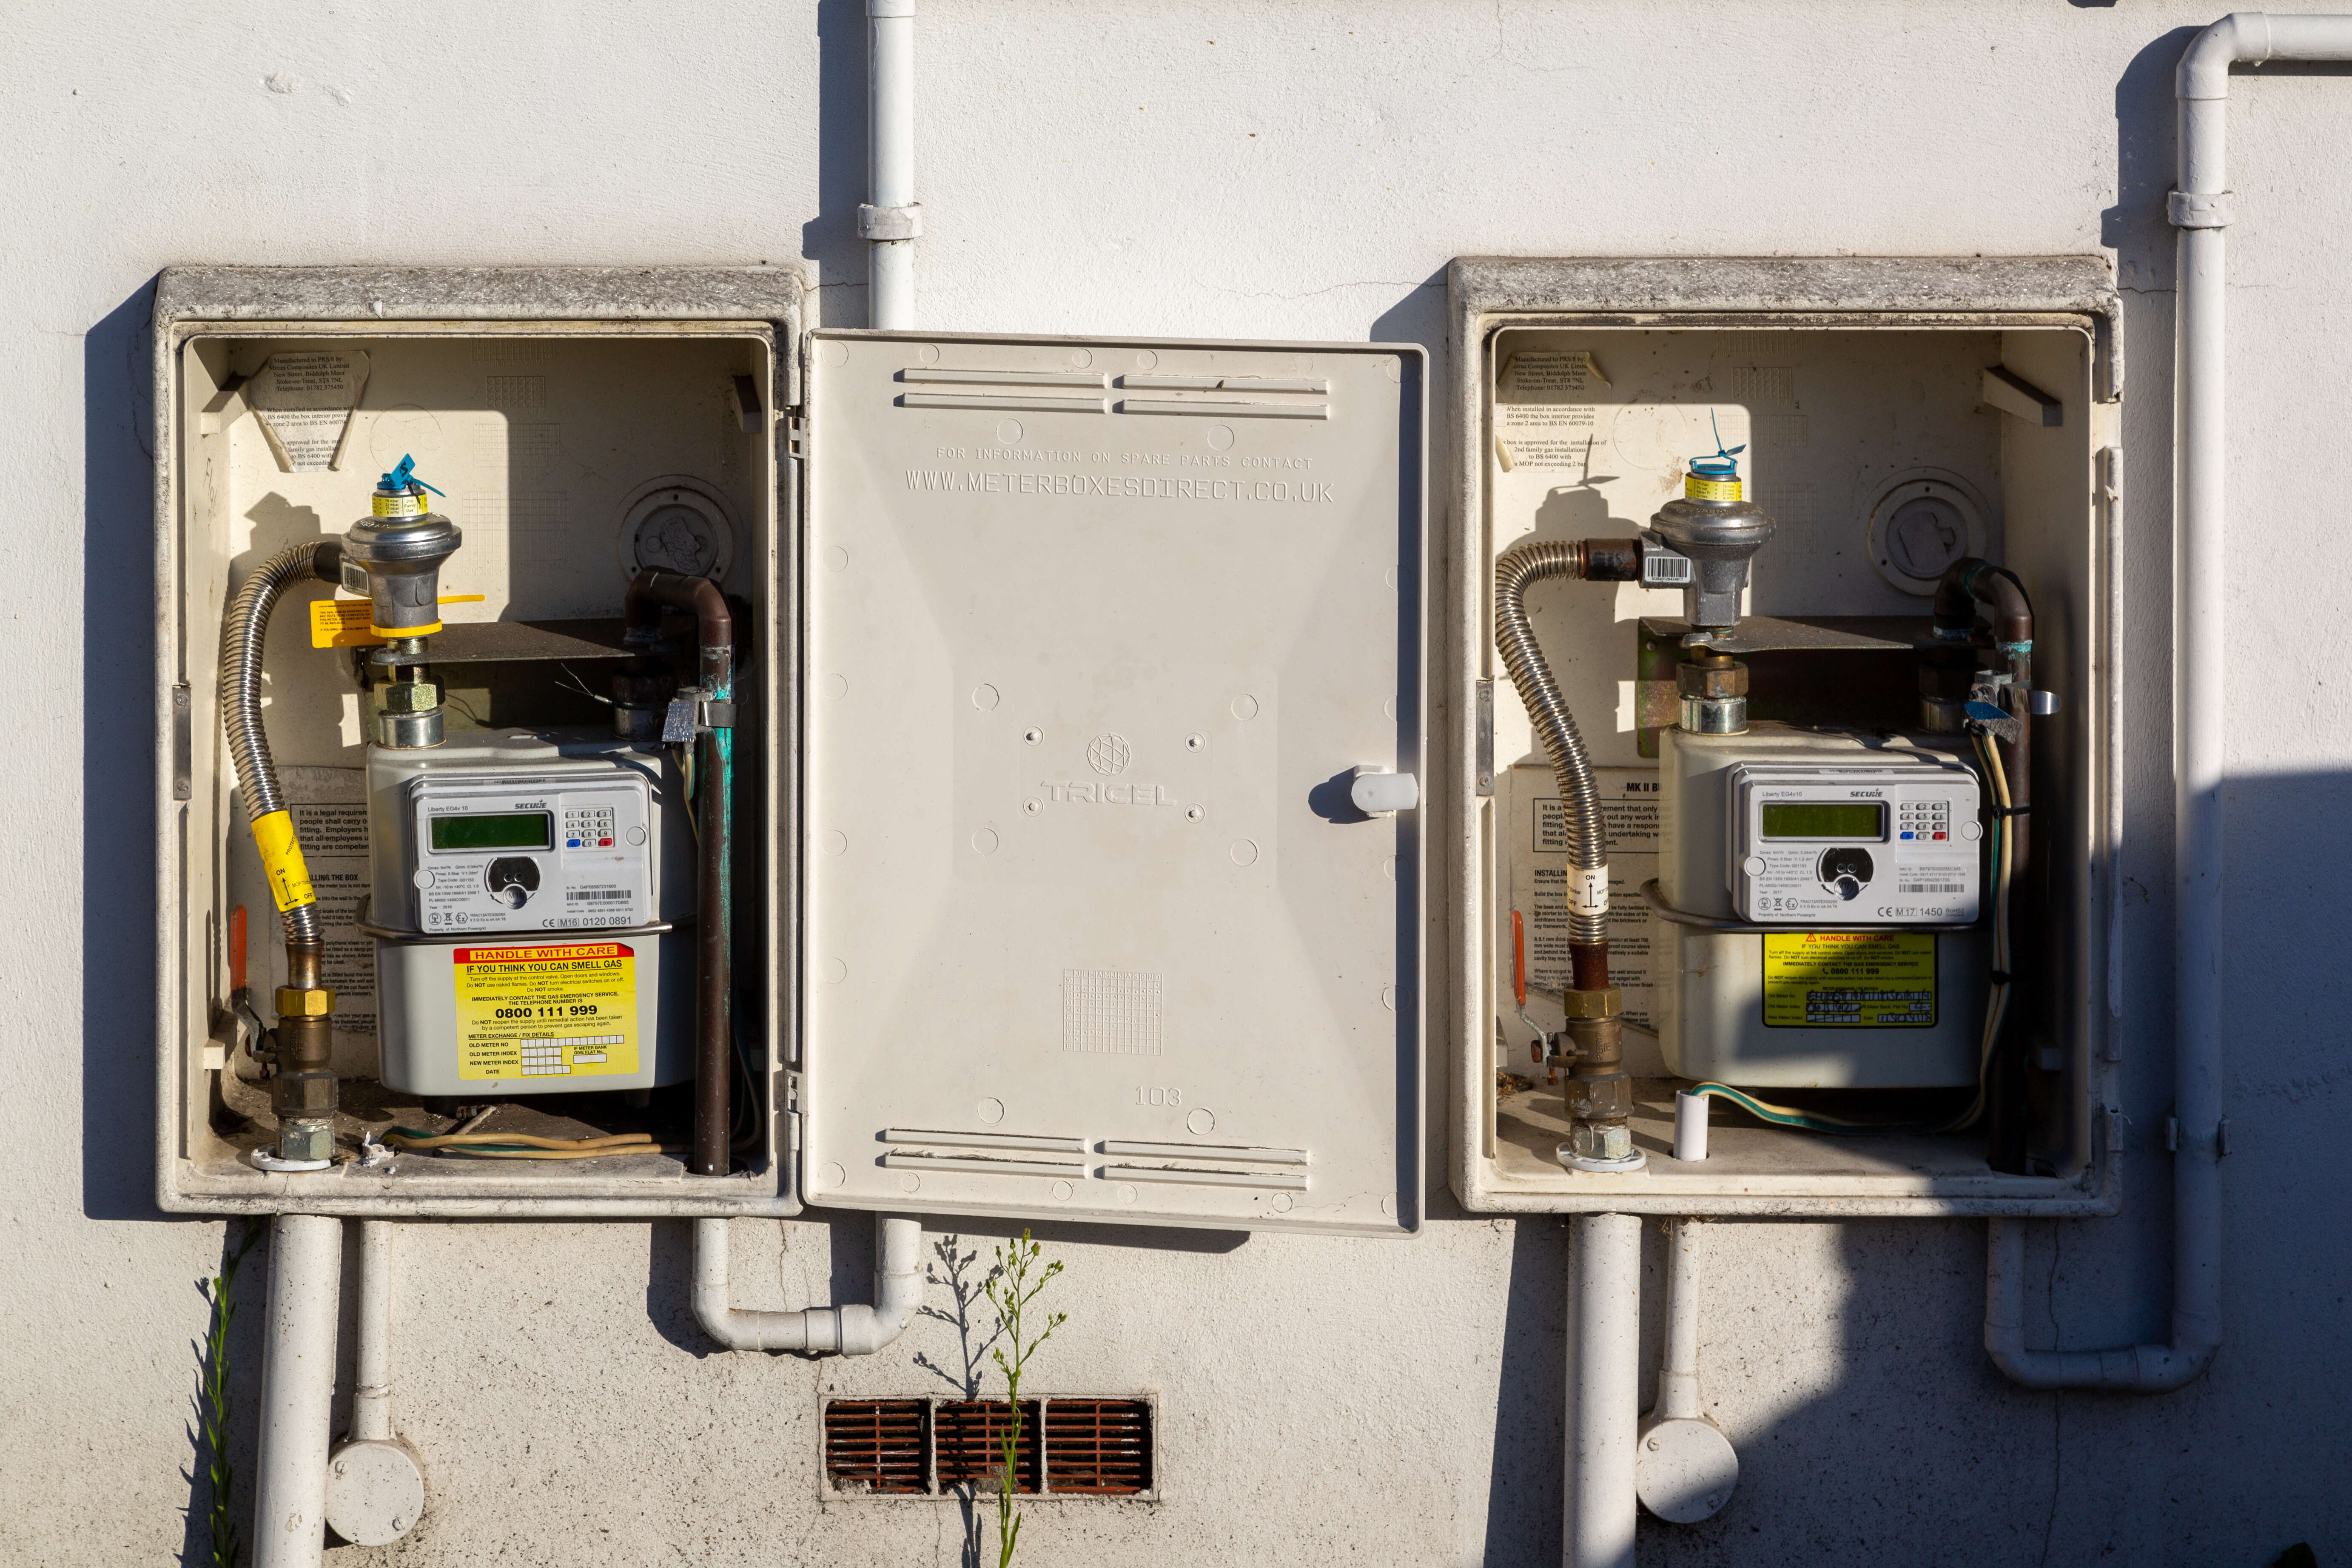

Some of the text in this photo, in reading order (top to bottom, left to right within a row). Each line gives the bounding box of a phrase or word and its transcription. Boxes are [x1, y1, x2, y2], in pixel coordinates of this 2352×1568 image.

[937, 447, 1312, 469] FOR INFORMATION ON SPARE PARTS CONTACT
[906, 470, 1334, 503] WWW.METERBOXESDIRECT.CO.UK
[1627, 783, 1649, 791] MK II
[1040, 780, 1177, 806] TRICEL
[1850, 788, 1883, 797] SECURE
[515, 800, 547, 809] SECURE
[1643, 805, 1658, 813] only
[320, 809, 337, 817] legal
[299, 826, 322, 834] fitting.
[276, 868, 285, 876] ON
[1920, 908, 1943, 916] 1450
[583, 917, 606, 926] 0120
[609, 916, 631, 925] 0891
[476, 947, 615, 959] HANDLE WITH CARE
[498, 964, 526, 972] THINK
[528, 963, 547, 971] YOU
[571, 961, 601, 969] SMELL
[604, 959, 622, 968] GAS
[495, 1005, 598, 1019] 0800 111 999
[1136, 1086, 1181, 1107] 103
